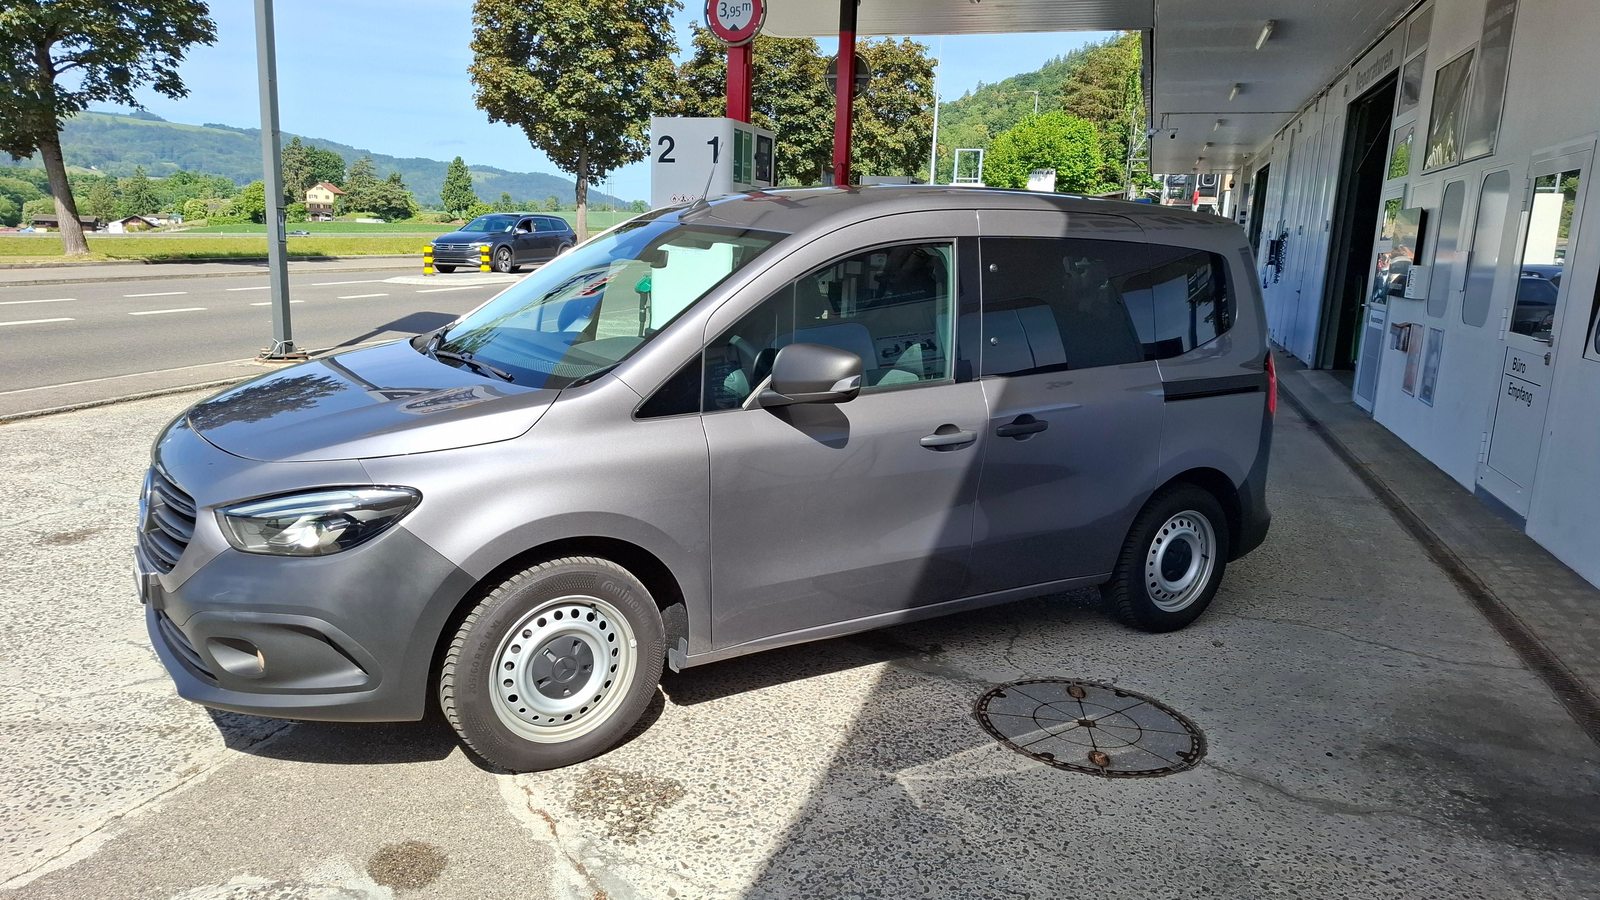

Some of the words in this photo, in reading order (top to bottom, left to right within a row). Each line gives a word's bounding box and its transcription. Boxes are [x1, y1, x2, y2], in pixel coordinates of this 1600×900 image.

[657, 135, 676, 163] 2
[707, 136, 719, 164] 1
[1512, 357, 1527, 374] Büro
[1507, 381, 1533, 408] Empfang
